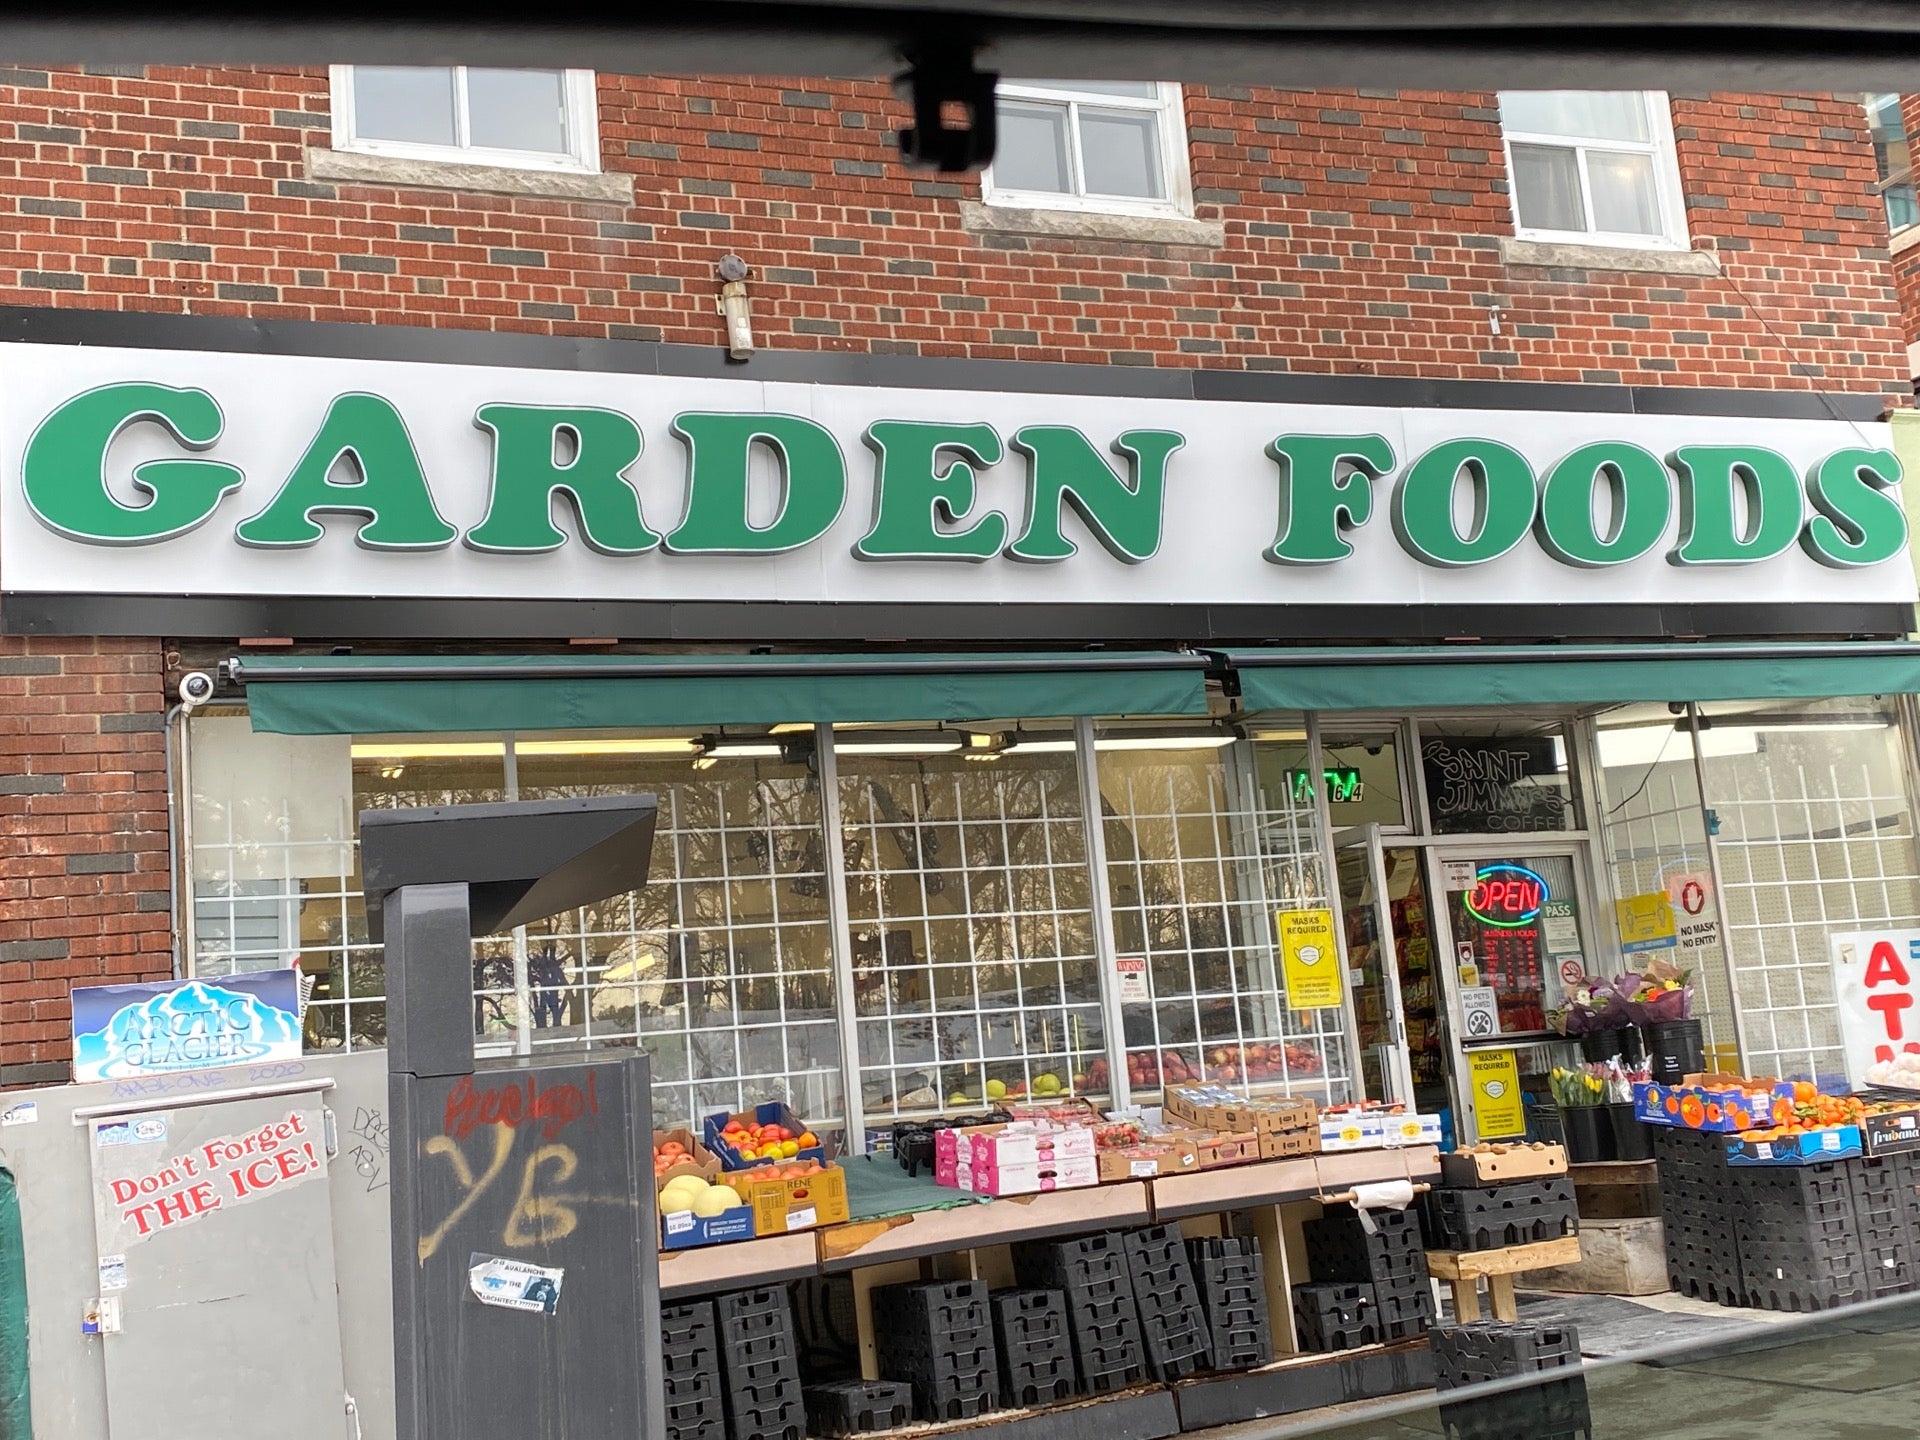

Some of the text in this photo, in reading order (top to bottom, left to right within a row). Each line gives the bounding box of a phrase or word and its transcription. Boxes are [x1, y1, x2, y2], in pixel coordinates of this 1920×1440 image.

[20, 381, 1908, 568] GARDEN FOODS
[1432, 746, 1530, 782] SAINT
[1294, 772, 1357, 798] AM
[1487, 815, 1567, 831] COFFEE
[1470, 881, 1540, 911] OPEN
[1545, 904, 1571, 917] PASS
[1291, 917, 1320, 925] MASKS
[1287, 925, 1328, 934] REQUIRED
[1681, 922, 1716, 936] NO MASK
[1682, 935, 1717, 948] NO ENTRY
[1463, 992, 1473, 1000] NO
[1464, 1000, 1491, 1008] ALLOWED
[123, 998, 251, 1043] ARCTIC
[124, 1033, 252, 1066] GLACIER
[1478, 1053, 1504, 1061] MASKS
[1474, 1061, 1511, 1070] REQUIRED
[110, 1156, 199, 1205] Don't
[203, 1114, 306, 1170] Forget
[122, 1143, 320, 1235] THE ICE!
[505, 1264, 546, 1276] AVALANCHE
